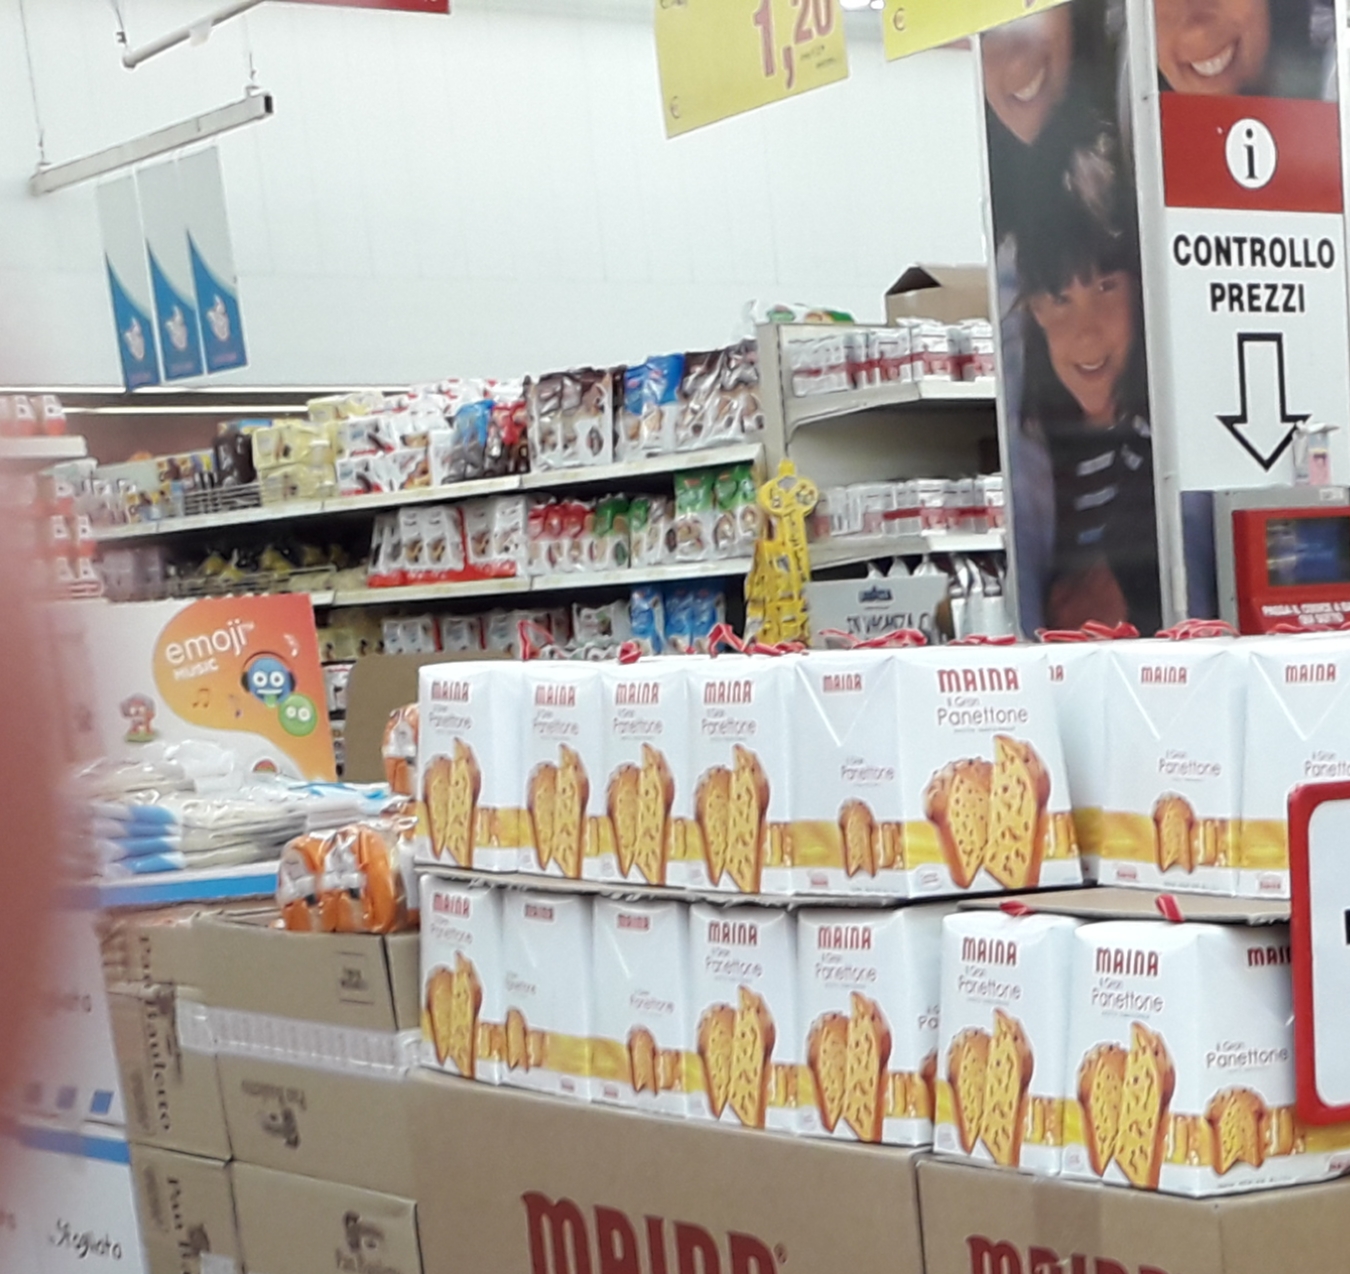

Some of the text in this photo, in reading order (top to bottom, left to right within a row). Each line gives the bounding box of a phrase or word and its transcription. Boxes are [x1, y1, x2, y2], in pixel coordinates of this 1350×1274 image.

[1173, 235, 1336, 270] CONTROLLO
[1209, 282, 1306, 314] PREZZI
[165, 620, 248, 665] emoji
[822, 673, 863, 692] MAINA
[937, 667, 1019, 693] MAINA
[1140, 666, 1188, 684] MAINA
[1285, 663, 1336, 683] MAINA
[430, 680, 470, 702] MAINA
[534, 684, 576, 707] MAINA
[614, 681, 660, 705] MAINA
[704, 680, 753, 704] MAINA
[937, 706, 1029, 726] Panettone
[708, 921, 758, 946] MAINA
[818, 925, 872, 951] MAINA
[961, 936, 1018, 967] MAINA
[1095, 947, 1160, 976] MAINA
[1091, 987, 1164, 1012] Panettone
[1206, 1047, 1289, 1069] Panettone
